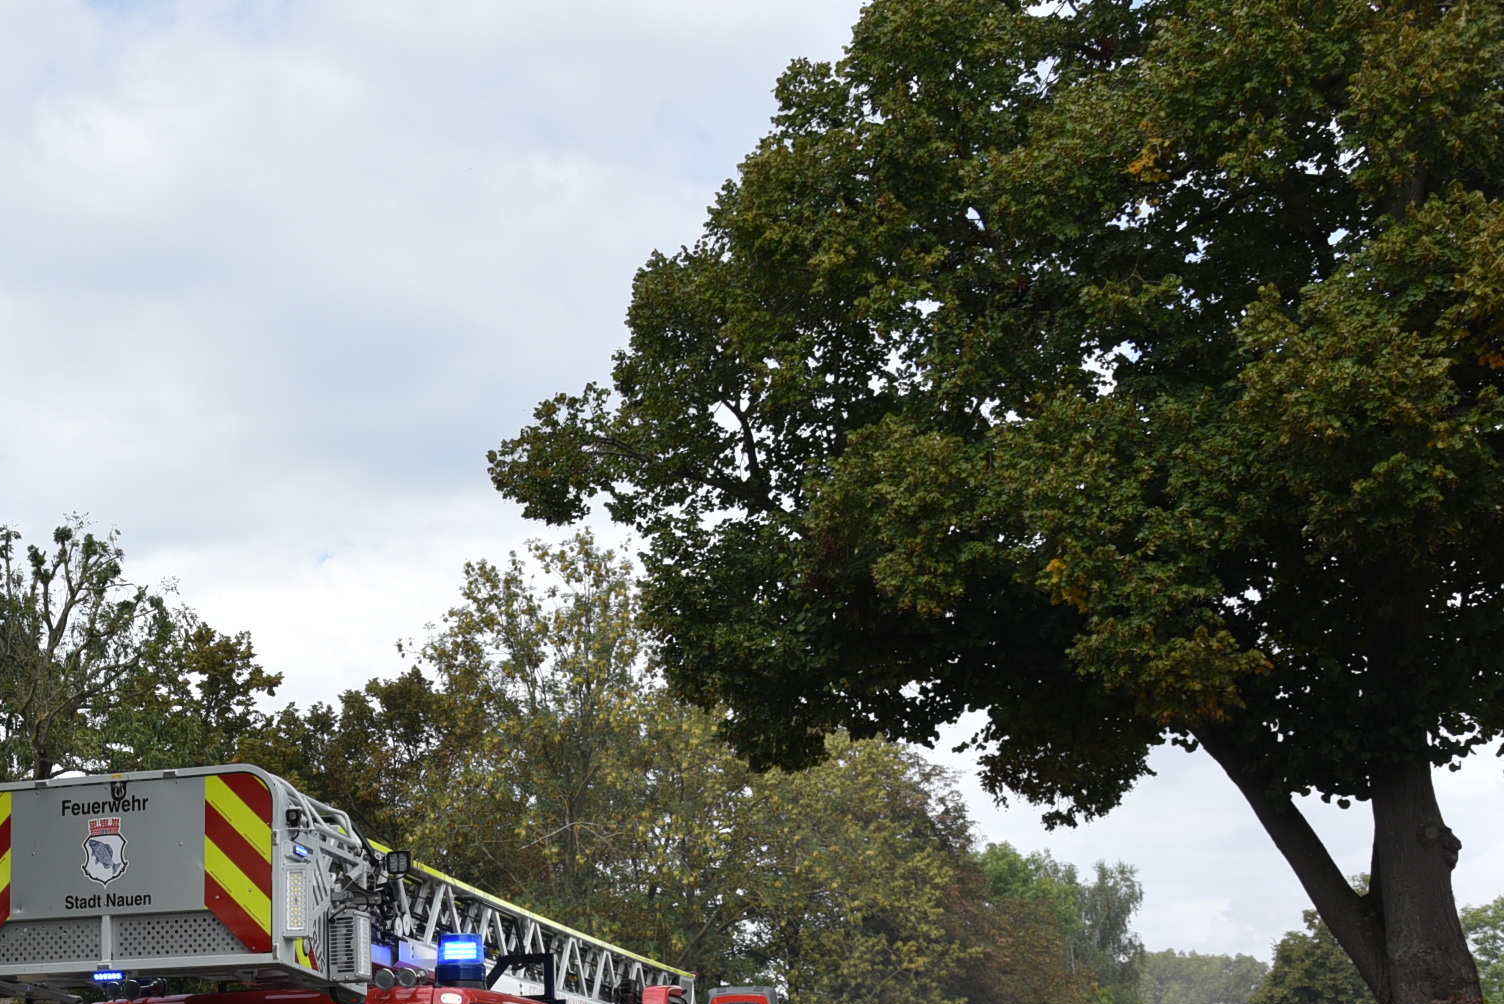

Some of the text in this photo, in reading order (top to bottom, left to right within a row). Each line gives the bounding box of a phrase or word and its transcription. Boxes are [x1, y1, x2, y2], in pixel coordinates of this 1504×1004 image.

[61, 795, 149, 816] Feuerwehr
[64, 893, 152, 910] Stadt Nauen
